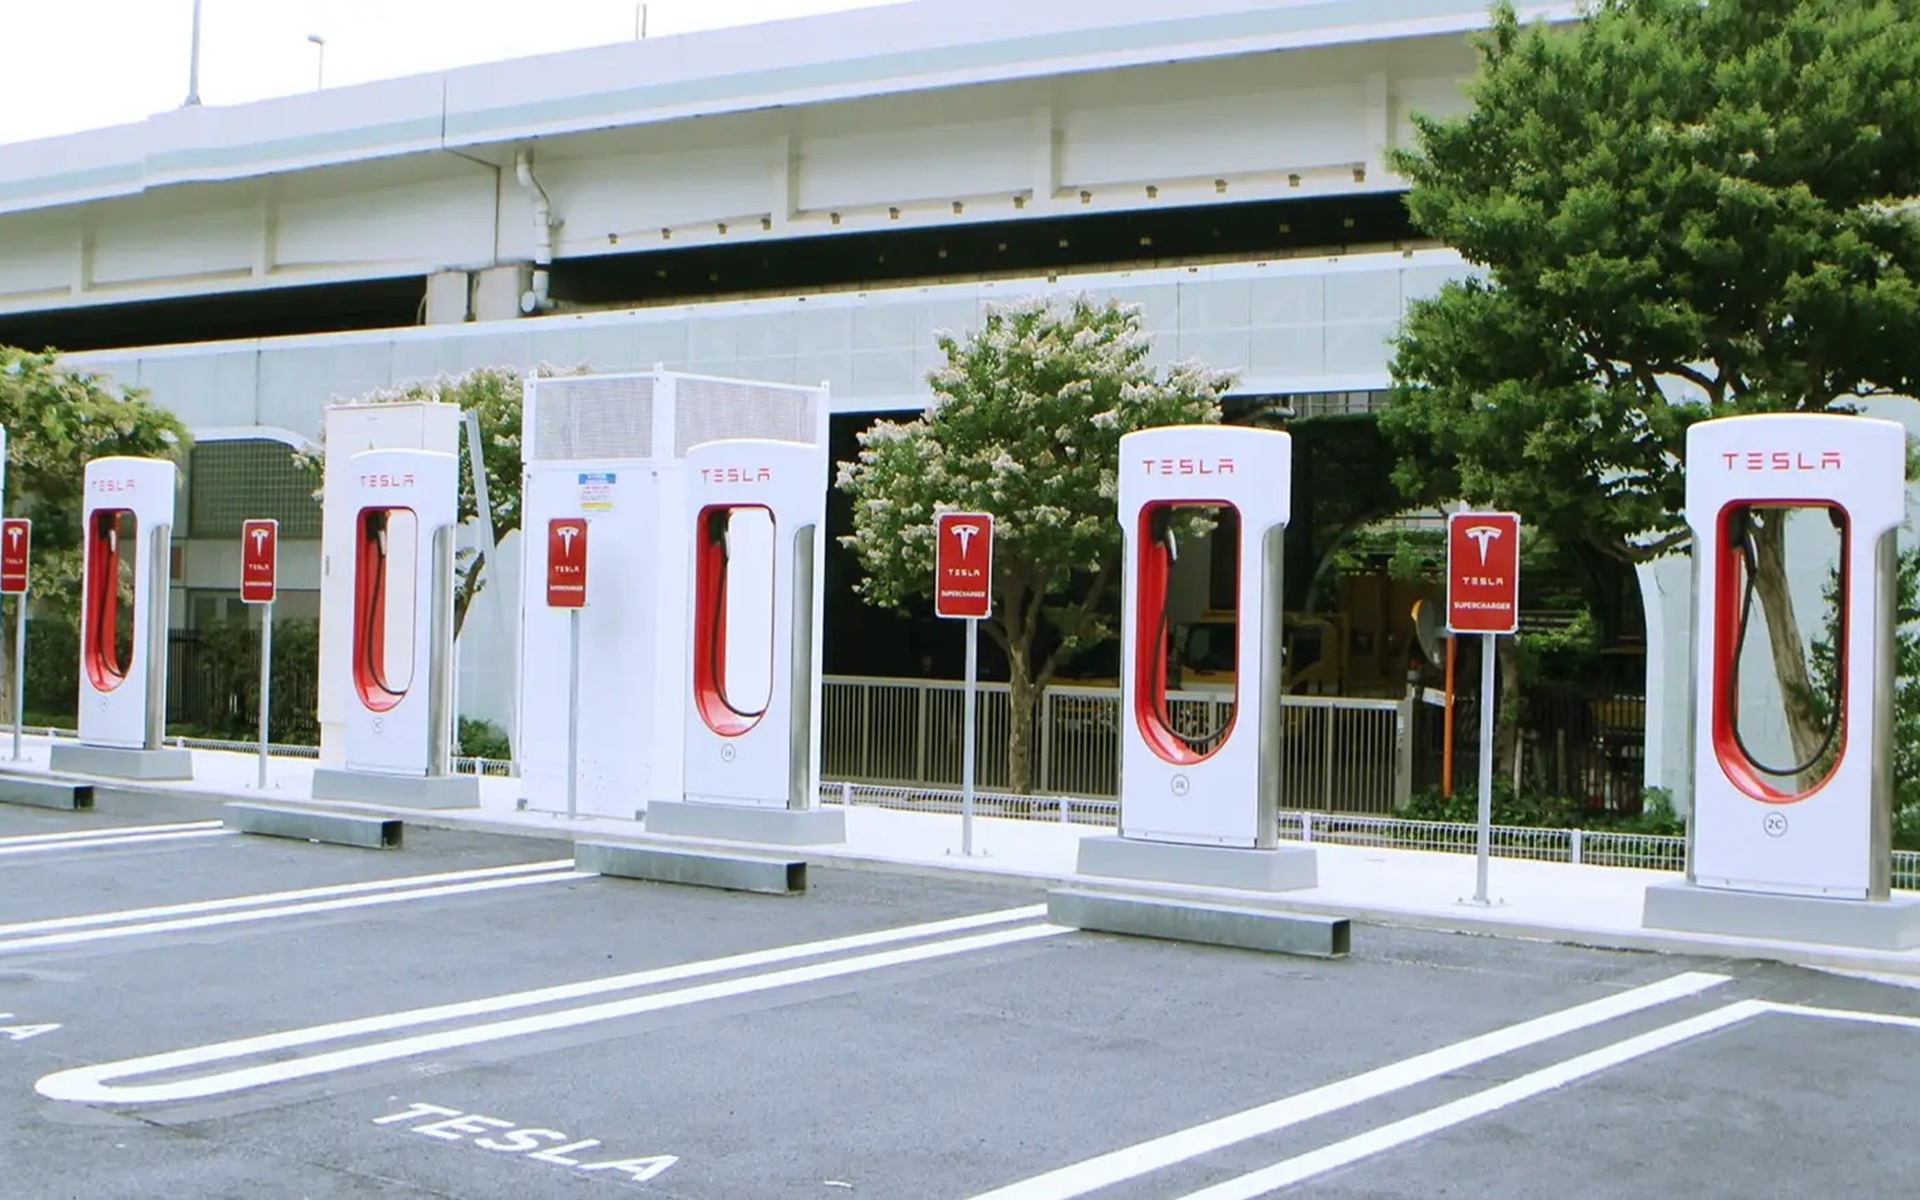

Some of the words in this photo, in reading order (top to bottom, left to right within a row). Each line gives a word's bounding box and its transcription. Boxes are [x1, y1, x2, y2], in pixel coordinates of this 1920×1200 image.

[1142, 458, 1234, 474] TESLA
[1722, 452, 1841, 470] TESLA
[360, 474, 414, 487] TESLA
[701, 467, 770, 483] TESLA
[947, 568, 981, 577] TESLA
[1462, 576, 1504, 586] TESLA
[1454, 601, 1511, 610] SUPERCHARGER
[1768, 819, 1783, 830] 2C
[372, 1102, 680, 1183] TESLA
